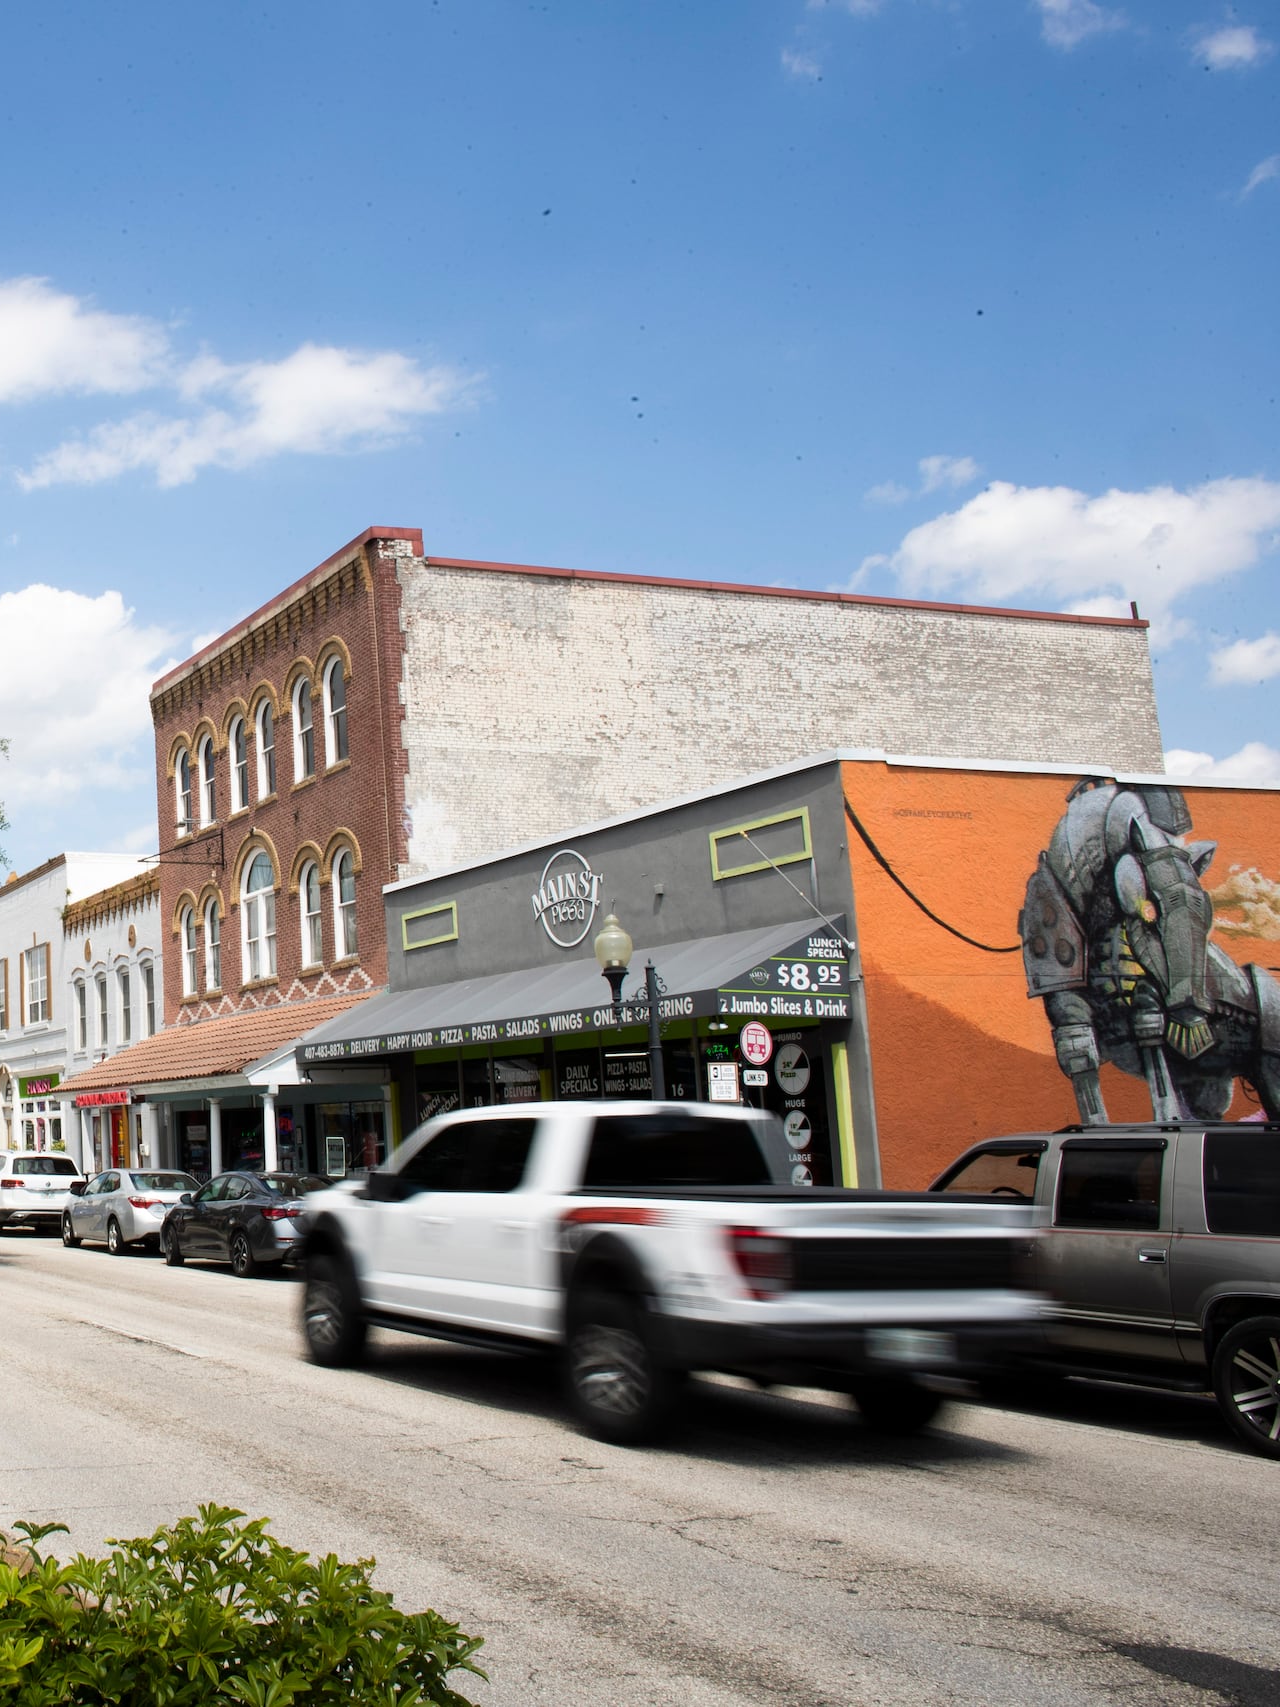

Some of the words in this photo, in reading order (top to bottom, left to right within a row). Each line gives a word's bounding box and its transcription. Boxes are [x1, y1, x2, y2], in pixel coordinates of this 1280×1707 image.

[809, 938, 841, 948] LUNCH
[807, 948, 845, 959] SPECIAL
[777, 963, 841, 992] $8.95
[720, 998, 728, 1013] 2
[731, 996, 768, 1014] Jumbo
[770, 996, 801, 1015] Slices
[804, 999, 813, 1015] &
[816, 999, 847, 1016] Drink
[305, 1043, 345, 1059] 407-483-8876
[350, 1039, 380, 1054] DELIVERY
[387, 1034, 410, 1050] HAPPY
[411, 1032, 433, 1048] HOUR
[440, 1028, 463, 1044] PIZZA
[471, 1024, 497, 1041] PASTA
[506, 1018, 540, 1037] SALADS
[549, 1012, 583, 1032] WINGS
[593, 1006, 632, 1027] ONLNE
[566, 1065, 589, 1080] DAILY
[607, 1062, 624, 1076] PIZZA
[628, 1060, 647, 1074] PASTA
[504, 1085, 536, 1098] DELIVERY
[560, 1078, 598, 1094] SPECIALS
[604, 1079, 625, 1093] WINGS
[629, 1078, 653, 1091] SALADS
[671, 1083, 684, 1097] 16
[420, 1094, 440, 1120] LUNCH
[785, 1099, 806, 1108] HUGE
[789, 1153, 812, 1162] LARGE
